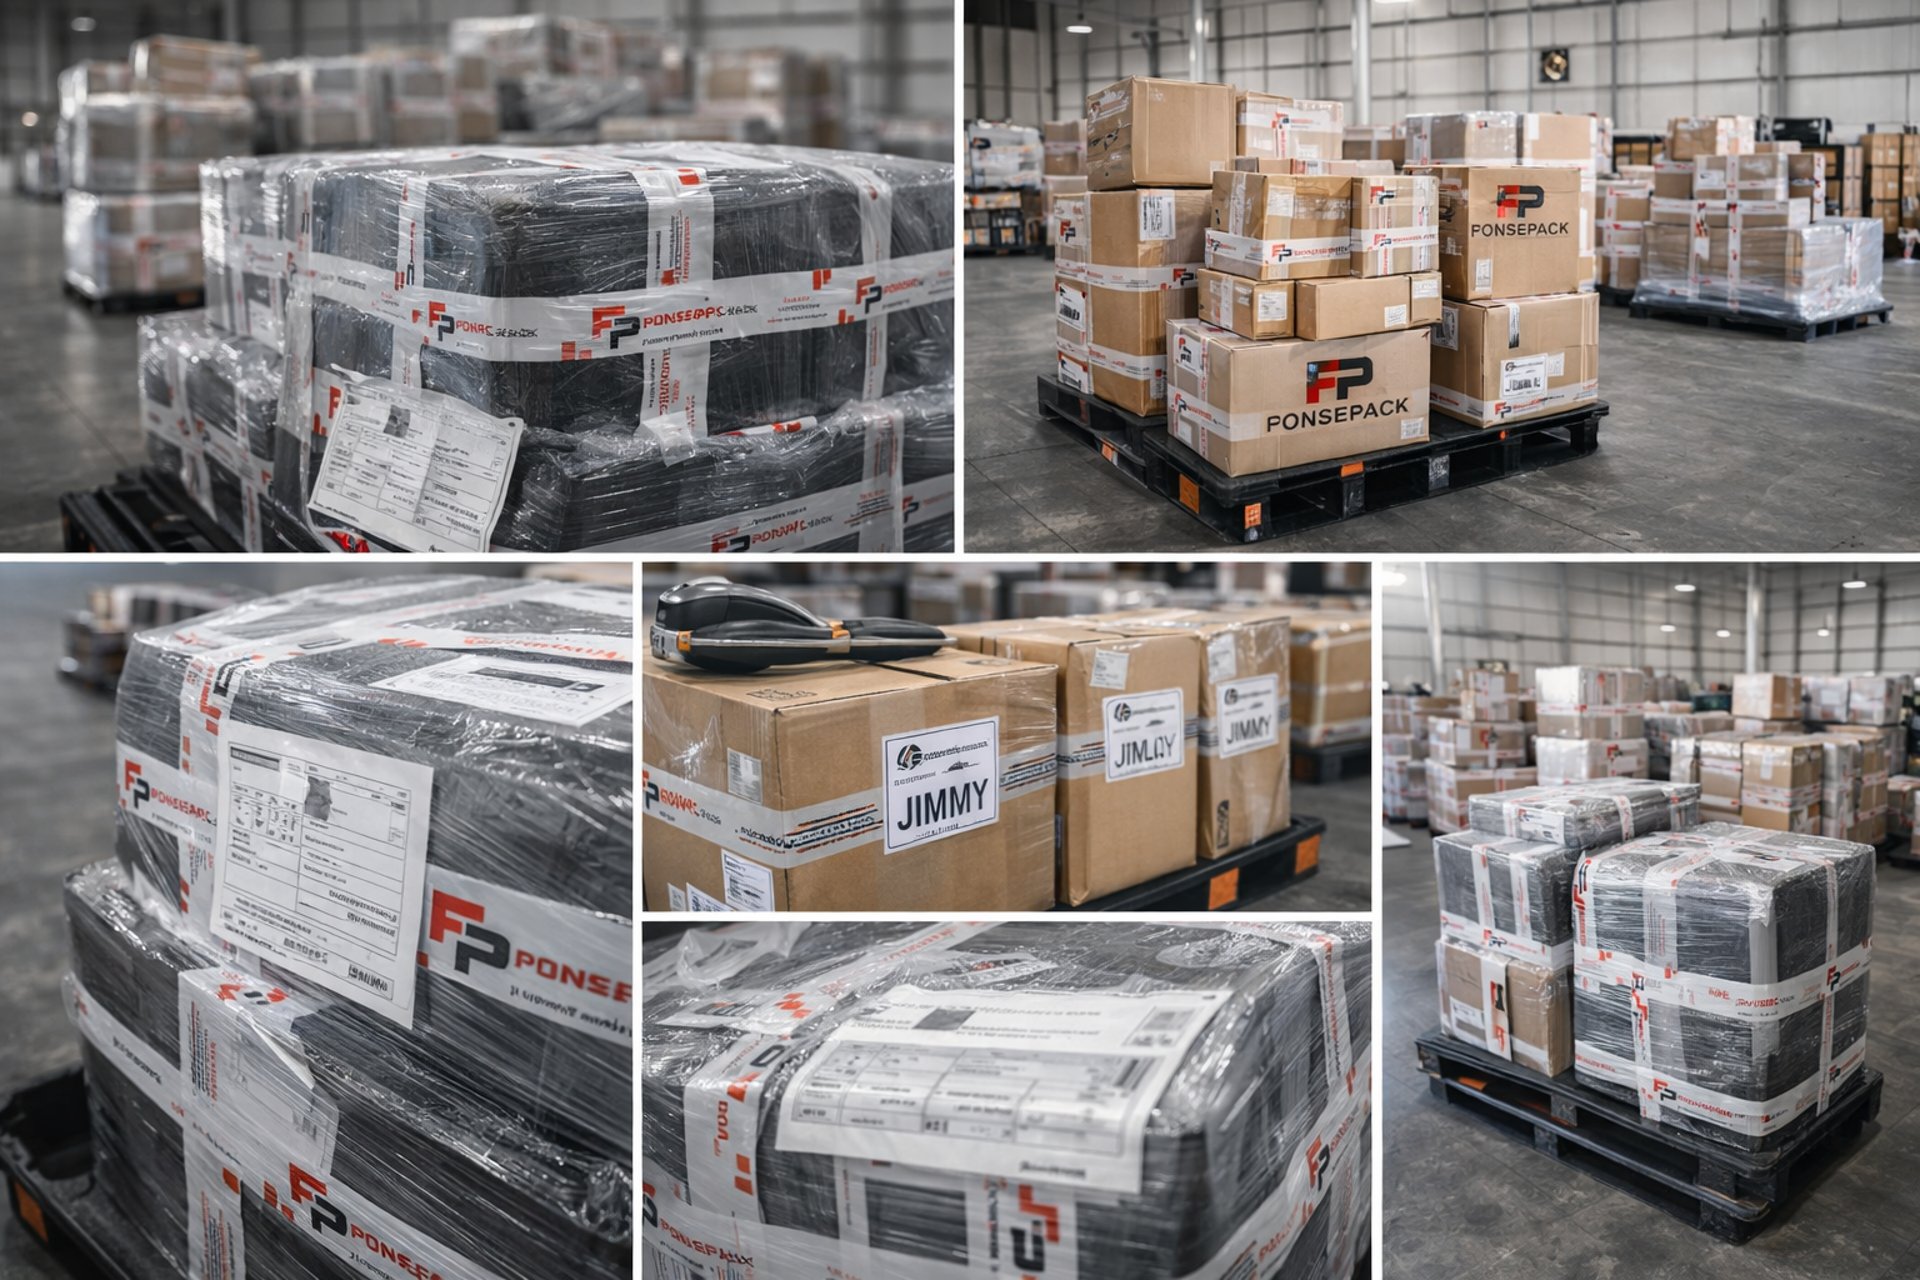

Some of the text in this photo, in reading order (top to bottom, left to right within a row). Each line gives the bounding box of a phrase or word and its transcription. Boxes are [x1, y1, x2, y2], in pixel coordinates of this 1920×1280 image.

[1471, 222, 1569, 237] PONSEPACK
[592, 305, 641, 349] FP
[1306, 356, 1373, 404] FP
[1267, 397, 1409, 432] PONSEPACK
[897, 778, 989, 831] JIMMY
[429, 889, 510, 975] FP
[289, 1162, 348, 1236] FP
